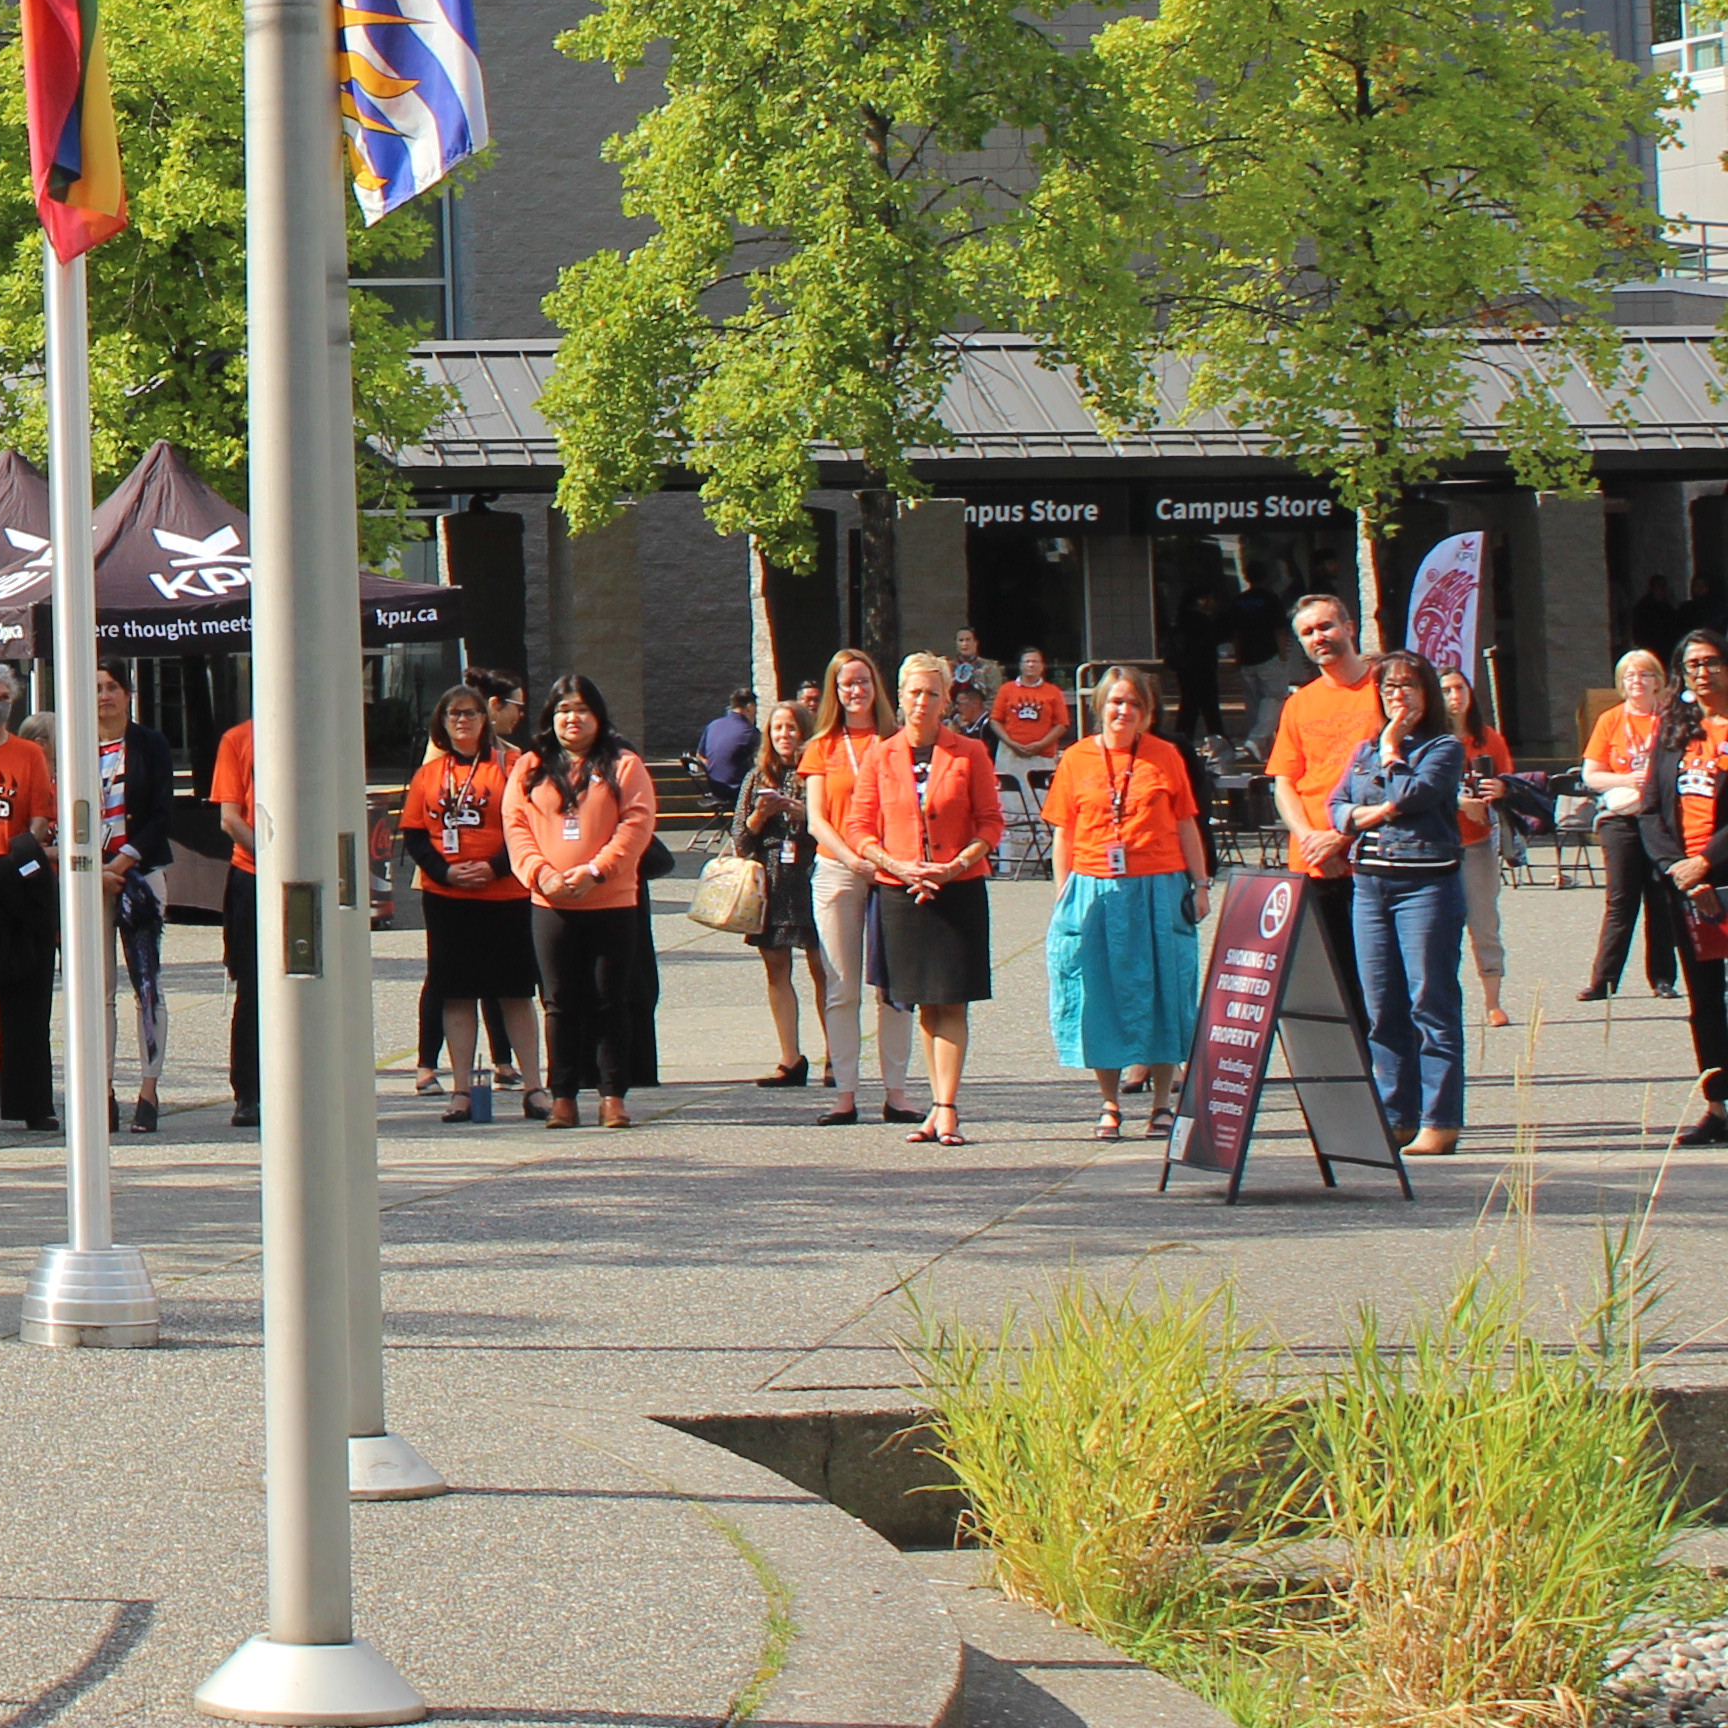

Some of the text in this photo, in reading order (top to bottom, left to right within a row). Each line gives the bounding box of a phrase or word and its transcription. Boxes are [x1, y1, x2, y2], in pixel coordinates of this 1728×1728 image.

[1030, 500, 1098, 522] Store
[1156, 496, 1332, 524] Campus Store
[149, 566, 252, 600] KP
[377, 608, 438, 629] kpu.ca
[123, 620, 198, 641] thought
[1224, 948, 1278, 971] SMOKING IS
[1216, 973, 1271, 997] PROHIBITED
[1226, 1000, 1265, 1022] ON KPU
[1209, 1025, 1260, 1048] PROPERTY
